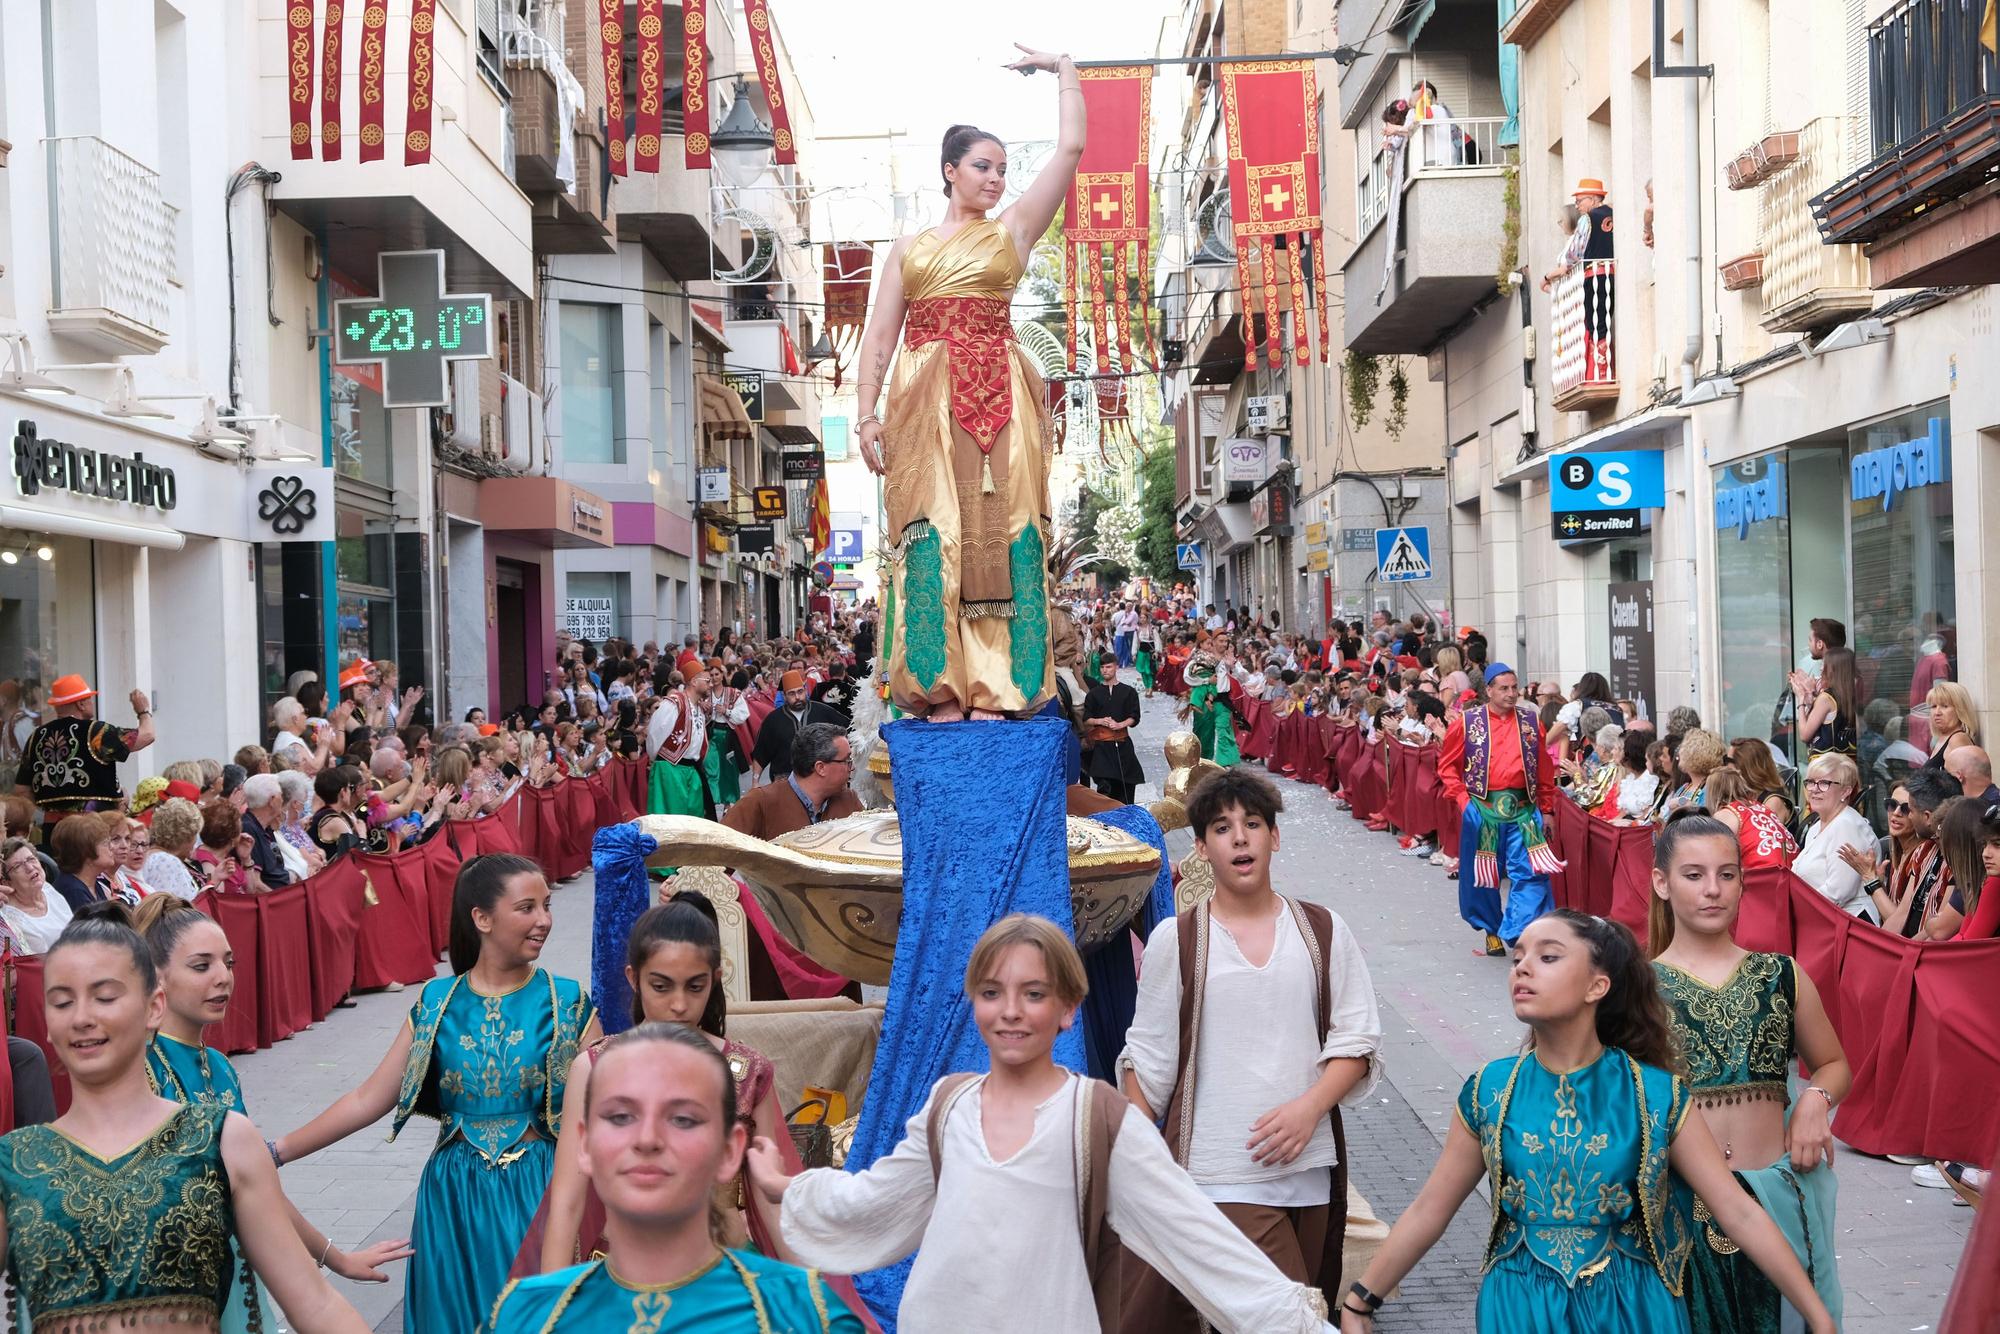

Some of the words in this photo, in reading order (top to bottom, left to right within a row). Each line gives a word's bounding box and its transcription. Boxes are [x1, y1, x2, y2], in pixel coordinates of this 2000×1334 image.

[727, 382, 760, 393] ORO
[1250, 398, 1259, 406] SE
[41, 438, 176, 510] encuentro
[1852, 417, 1942, 512] mayoral
[1569, 465, 1585, 482] B
[1597, 461, 1632, 506] S
[1716, 462, 1781, 541] mayoral
[1354, 529, 1374, 537] CALLE
[1583, 517, 1634, 531] ServiRed
[834, 531, 854, 555] P
[577, 599, 611, 612] ALQUILA
[1611, 594, 1639, 628] Cuenta
[566, 615, 580, 626] 695
[582, 615, 595, 626] 798
[596, 615, 610, 626] 624
[582, 627, 596, 639] 232
[1612, 635, 1627, 660] con
